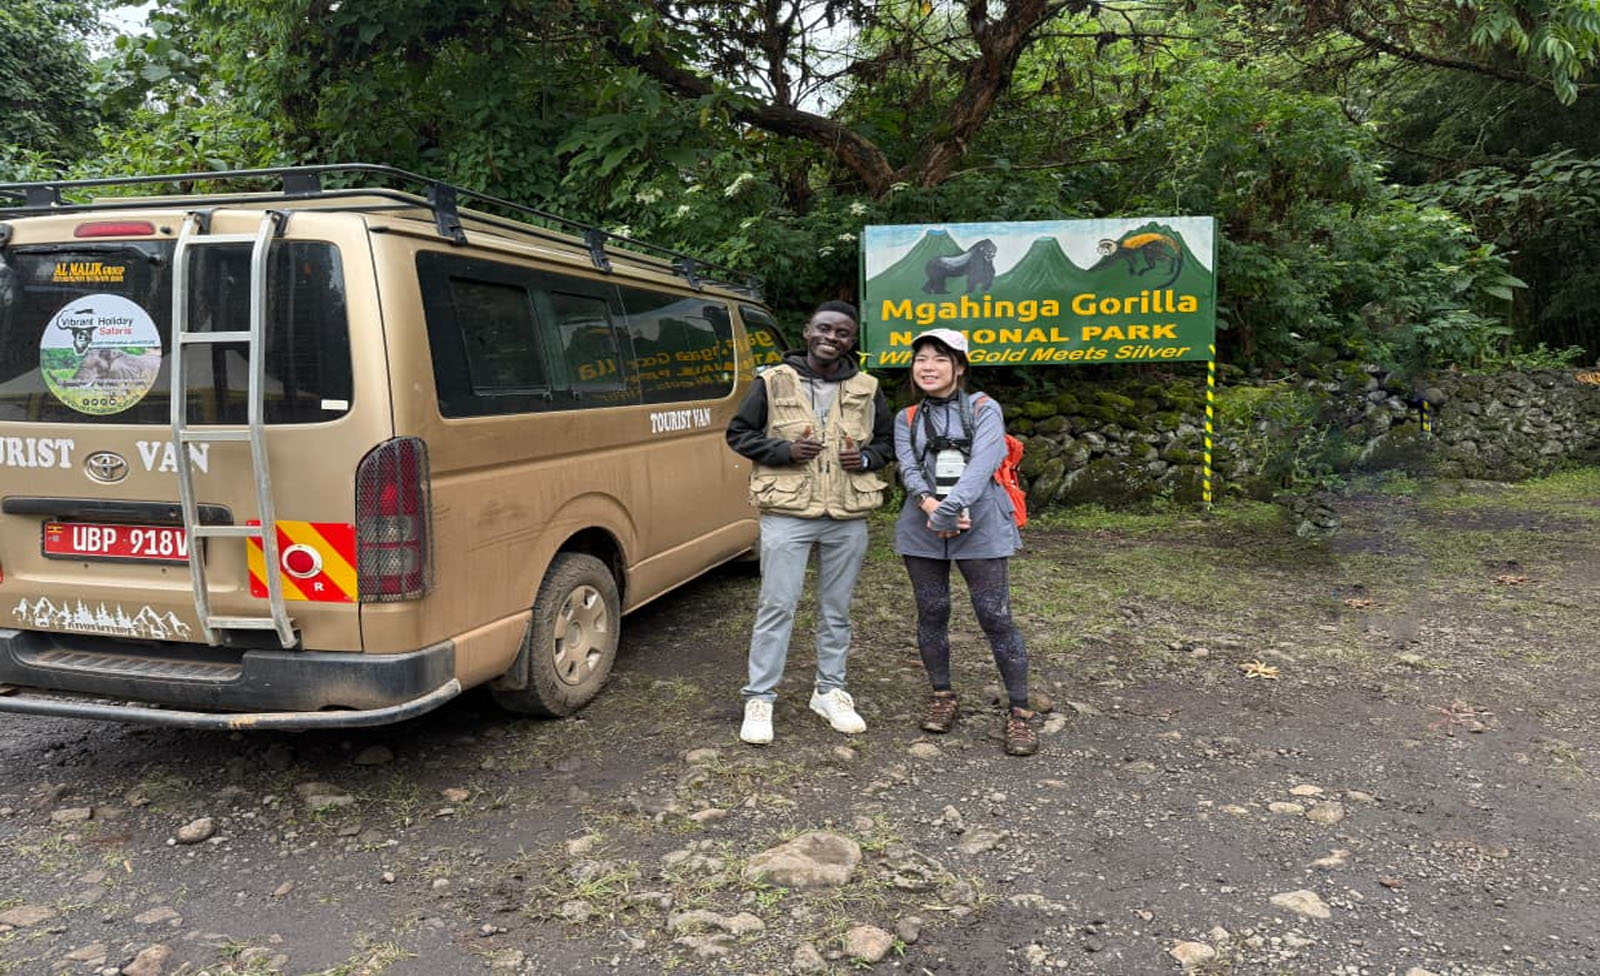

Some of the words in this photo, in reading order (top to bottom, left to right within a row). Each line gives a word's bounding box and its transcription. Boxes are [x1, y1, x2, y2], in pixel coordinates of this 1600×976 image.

[881, 294, 1060, 325] Mgahinga
[1072, 289, 1198, 316] Gorilla
[98, 317, 133, 327] Holiday
[889, 327, 1071, 347] NONAL
[1082, 324, 1178, 341] PARK
[966, 348, 1028, 363] Gold
[1030, 346, 1109, 361] Meets
[1114, 344, 1192, 359] Silver
[650, 410, 691, 433] TOURIST
[692, 407, 711, 429] VAN
[136, 441, 210, 474] VAN
[72, 526, 117, 552] UBP
[313, 582, 325, 592] R
